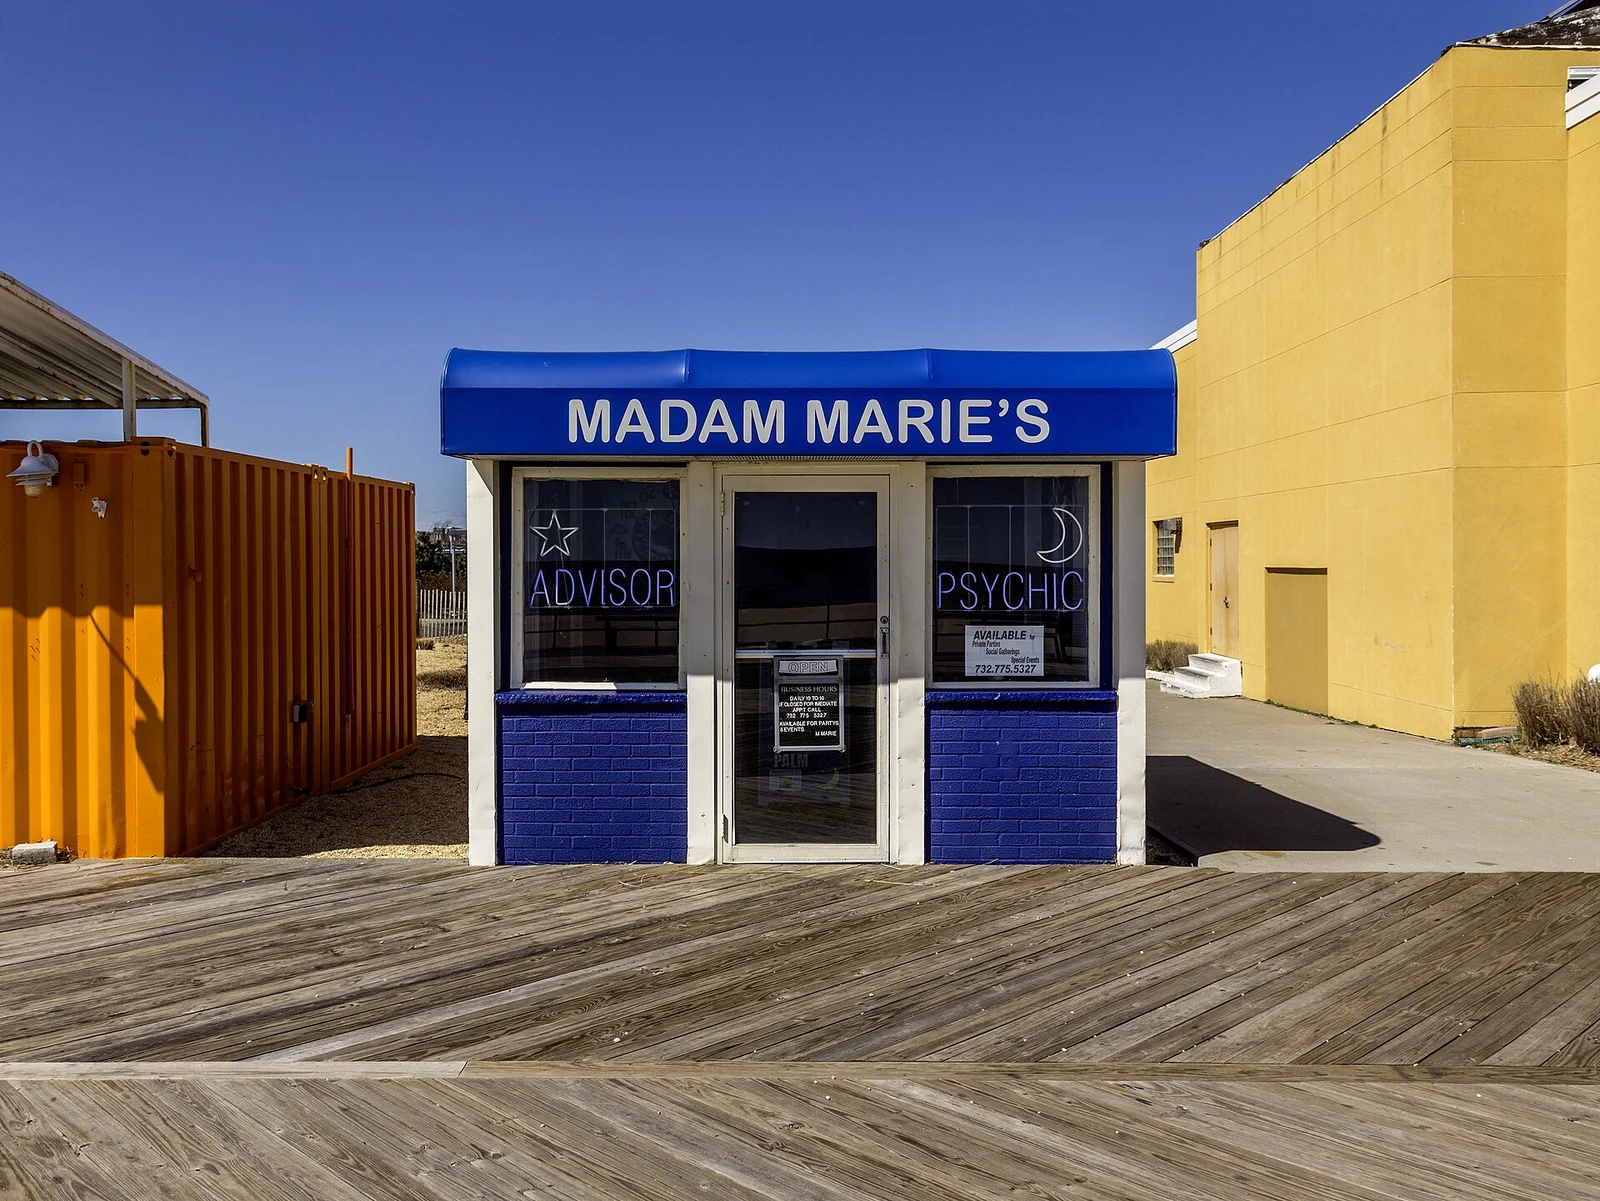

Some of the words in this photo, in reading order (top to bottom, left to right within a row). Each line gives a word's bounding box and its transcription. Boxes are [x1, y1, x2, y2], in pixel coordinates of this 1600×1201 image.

[568, 398, 786, 444] MADAM
[806, 398, 1050, 444] MARIE'S
[530, 567, 675, 607] ADVISOR
[937, 570, 1084, 611] PSYCHIC
[973, 630, 1027, 640] AVAILABLE
[998, 648, 1020, 657] Gatherings
[1010, 656, 1025, 665] Special
[1025, 656, 1040, 664] Events
[787, 661, 829, 673] OPEN
[975, 664, 1037, 674] 732.775.5327
[773, 753, 809, 768] PALM
